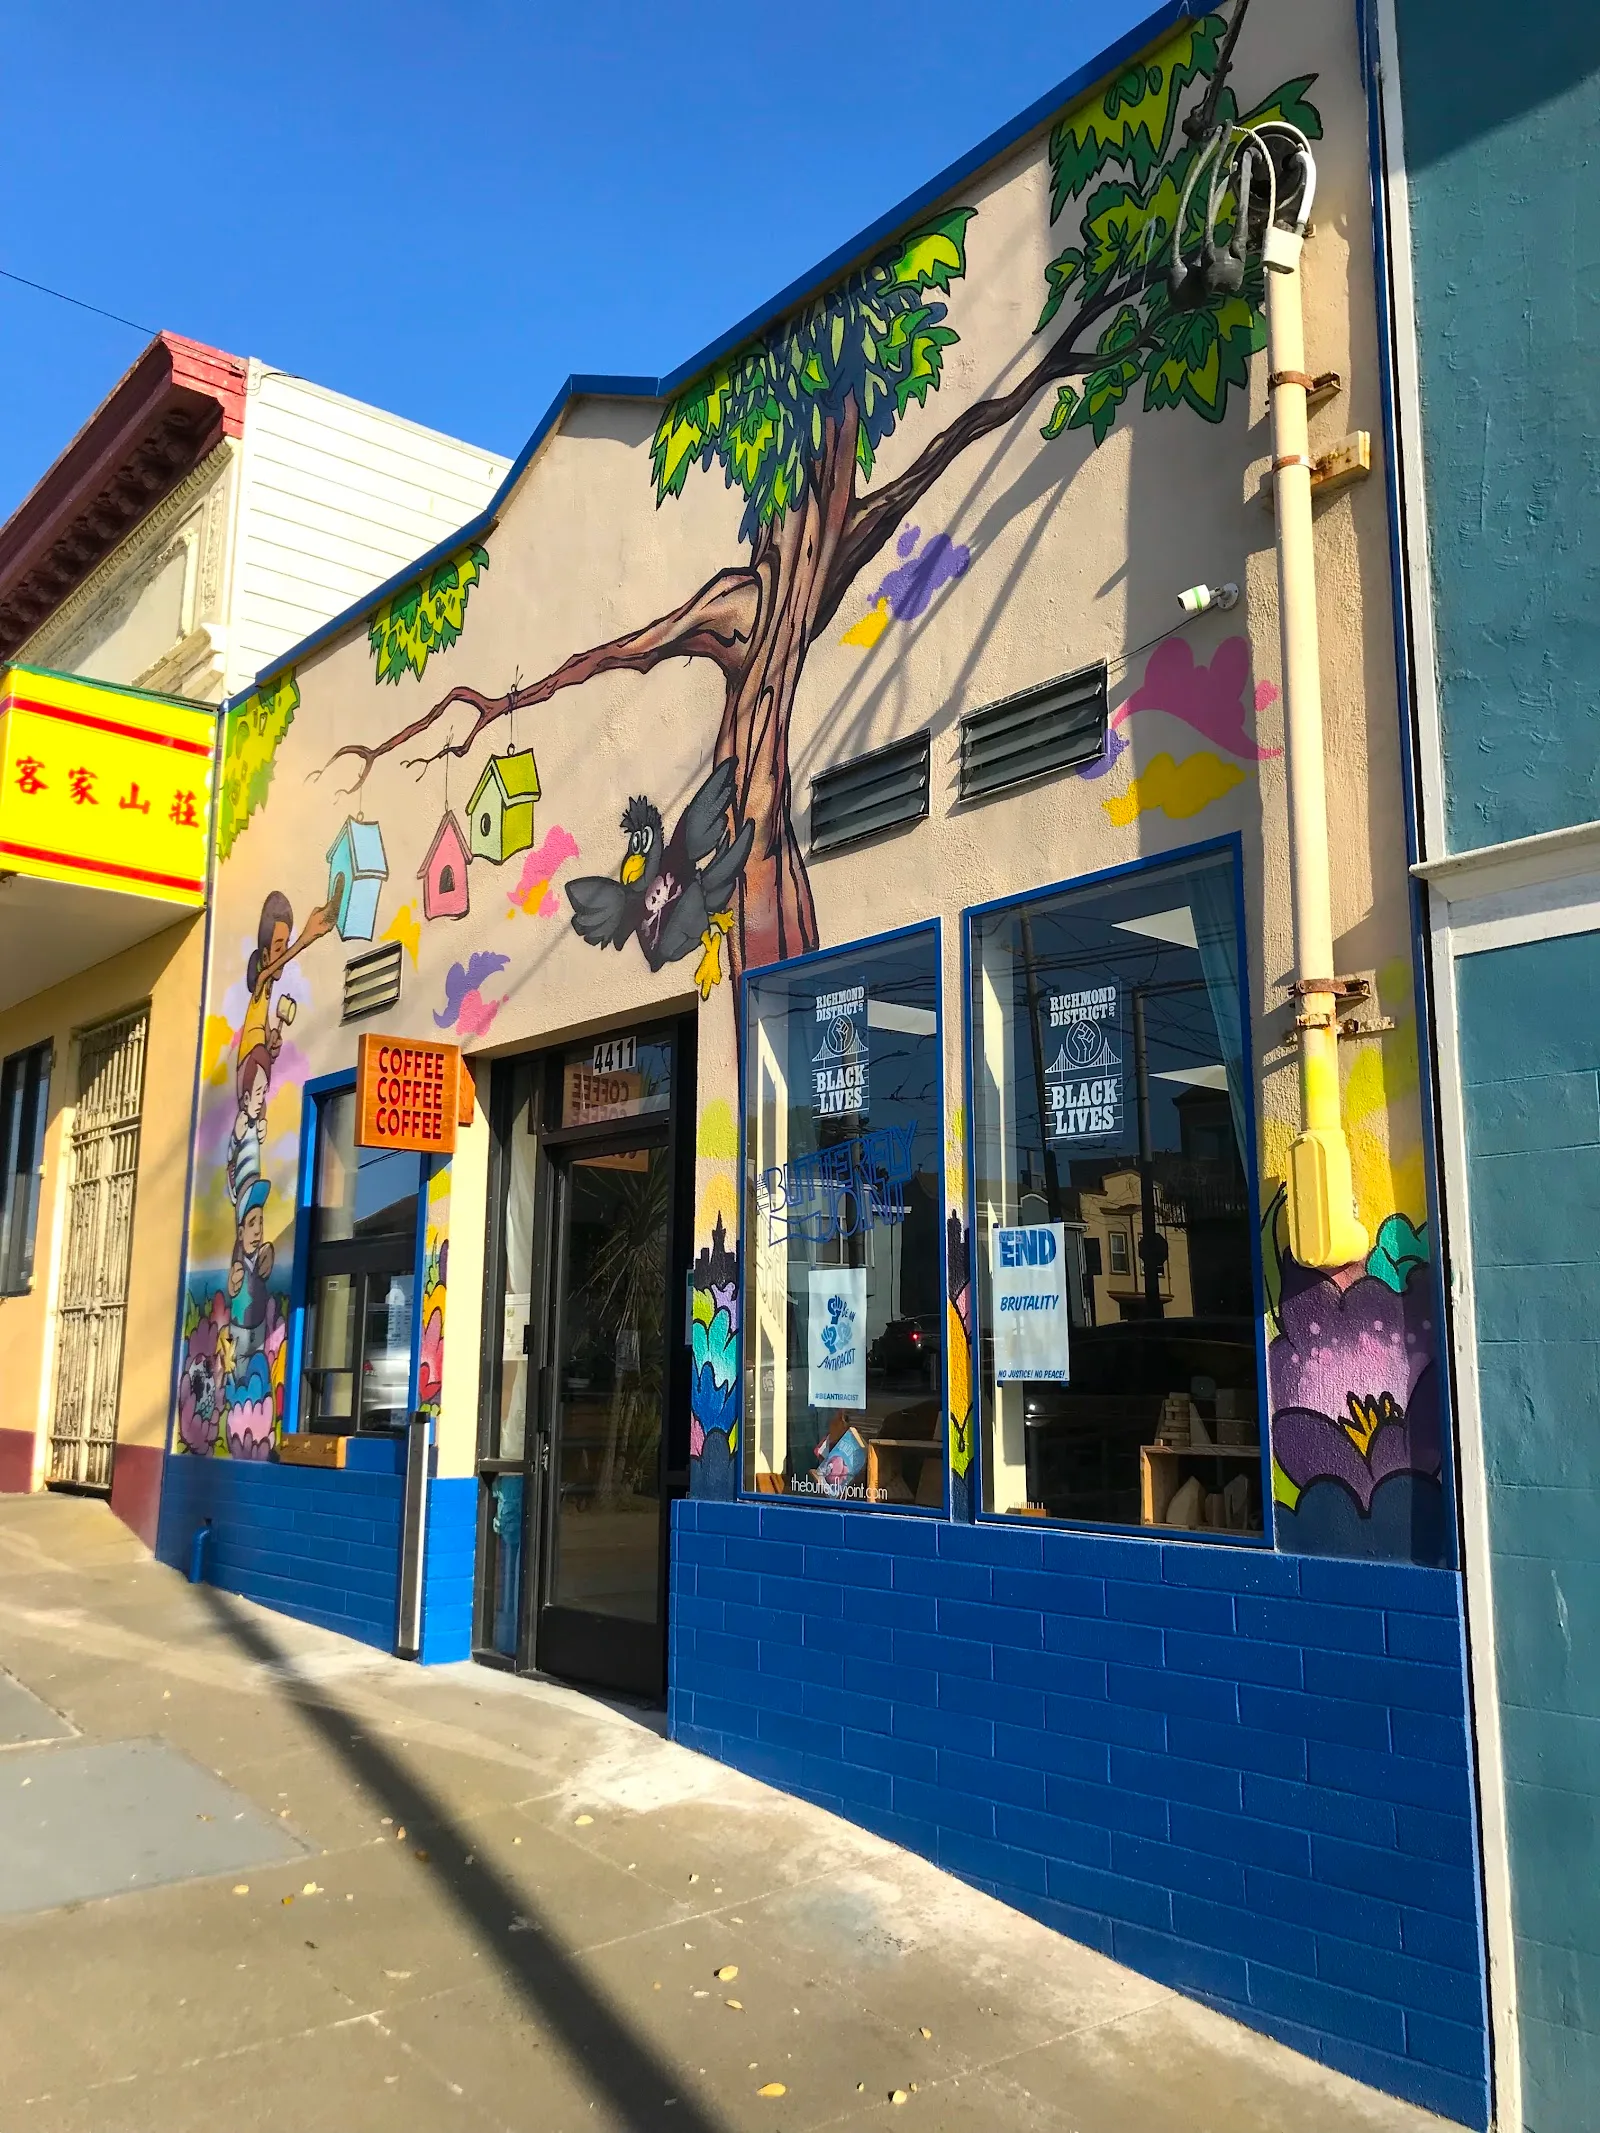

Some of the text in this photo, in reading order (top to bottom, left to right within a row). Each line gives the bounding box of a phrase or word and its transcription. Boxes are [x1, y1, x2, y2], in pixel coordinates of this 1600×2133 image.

[816, 986, 865, 1010] RICHMOND
[816, 1001, 859, 1022] DISTRICT
[1050, 986, 1116, 1012] RICHMOND
[1050, 1003, 1108, 1027] DISTRICT
[378, 1046, 445, 1080] COFFEE
[594, 1038, 634, 1073] 4411
[377, 1076, 443, 1110] COFFEE
[816, 1065, 866, 1093] BLACK
[819, 1088, 863, 1114] LIVES
[1051, 1078, 1118, 1110] BLACK
[376, 1107, 442, 1140] COFFEE
[1055, 1105, 1115, 1134] LIVES
[764, 1120, 918, 1213] BUTTERFLY
[999, 1228, 1056, 1267] END
[1000, 1294, 1059, 1312] BRUTALITY
[998, 1369, 1066, 1378] NO JUSTICE! NO PEACE!
[791, 1473, 888, 1500] thebutterflyjoint.com
